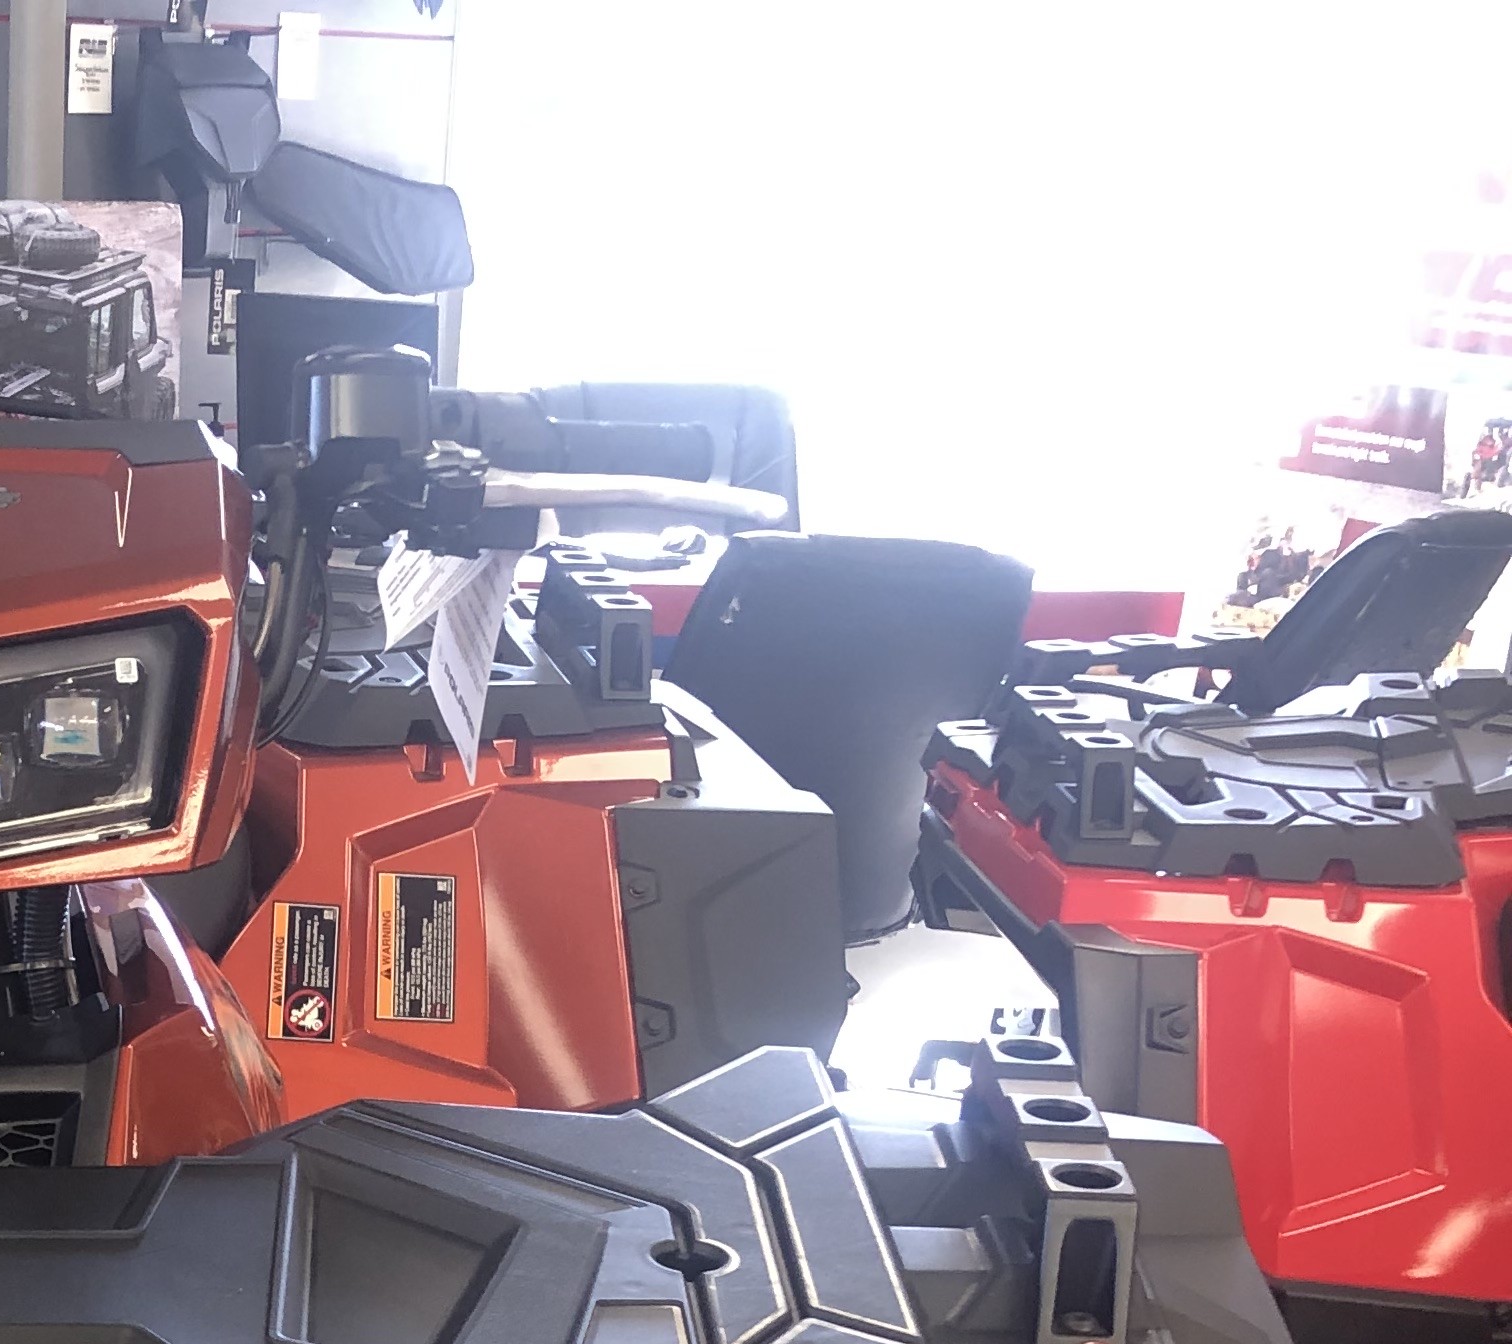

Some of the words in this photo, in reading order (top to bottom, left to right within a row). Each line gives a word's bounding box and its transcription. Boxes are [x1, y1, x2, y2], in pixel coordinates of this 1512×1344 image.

[211, 268, 224, 345] POLARIS
[274, 936, 285, 993] WARNING
[382, 910, 392, 966] WARNING
